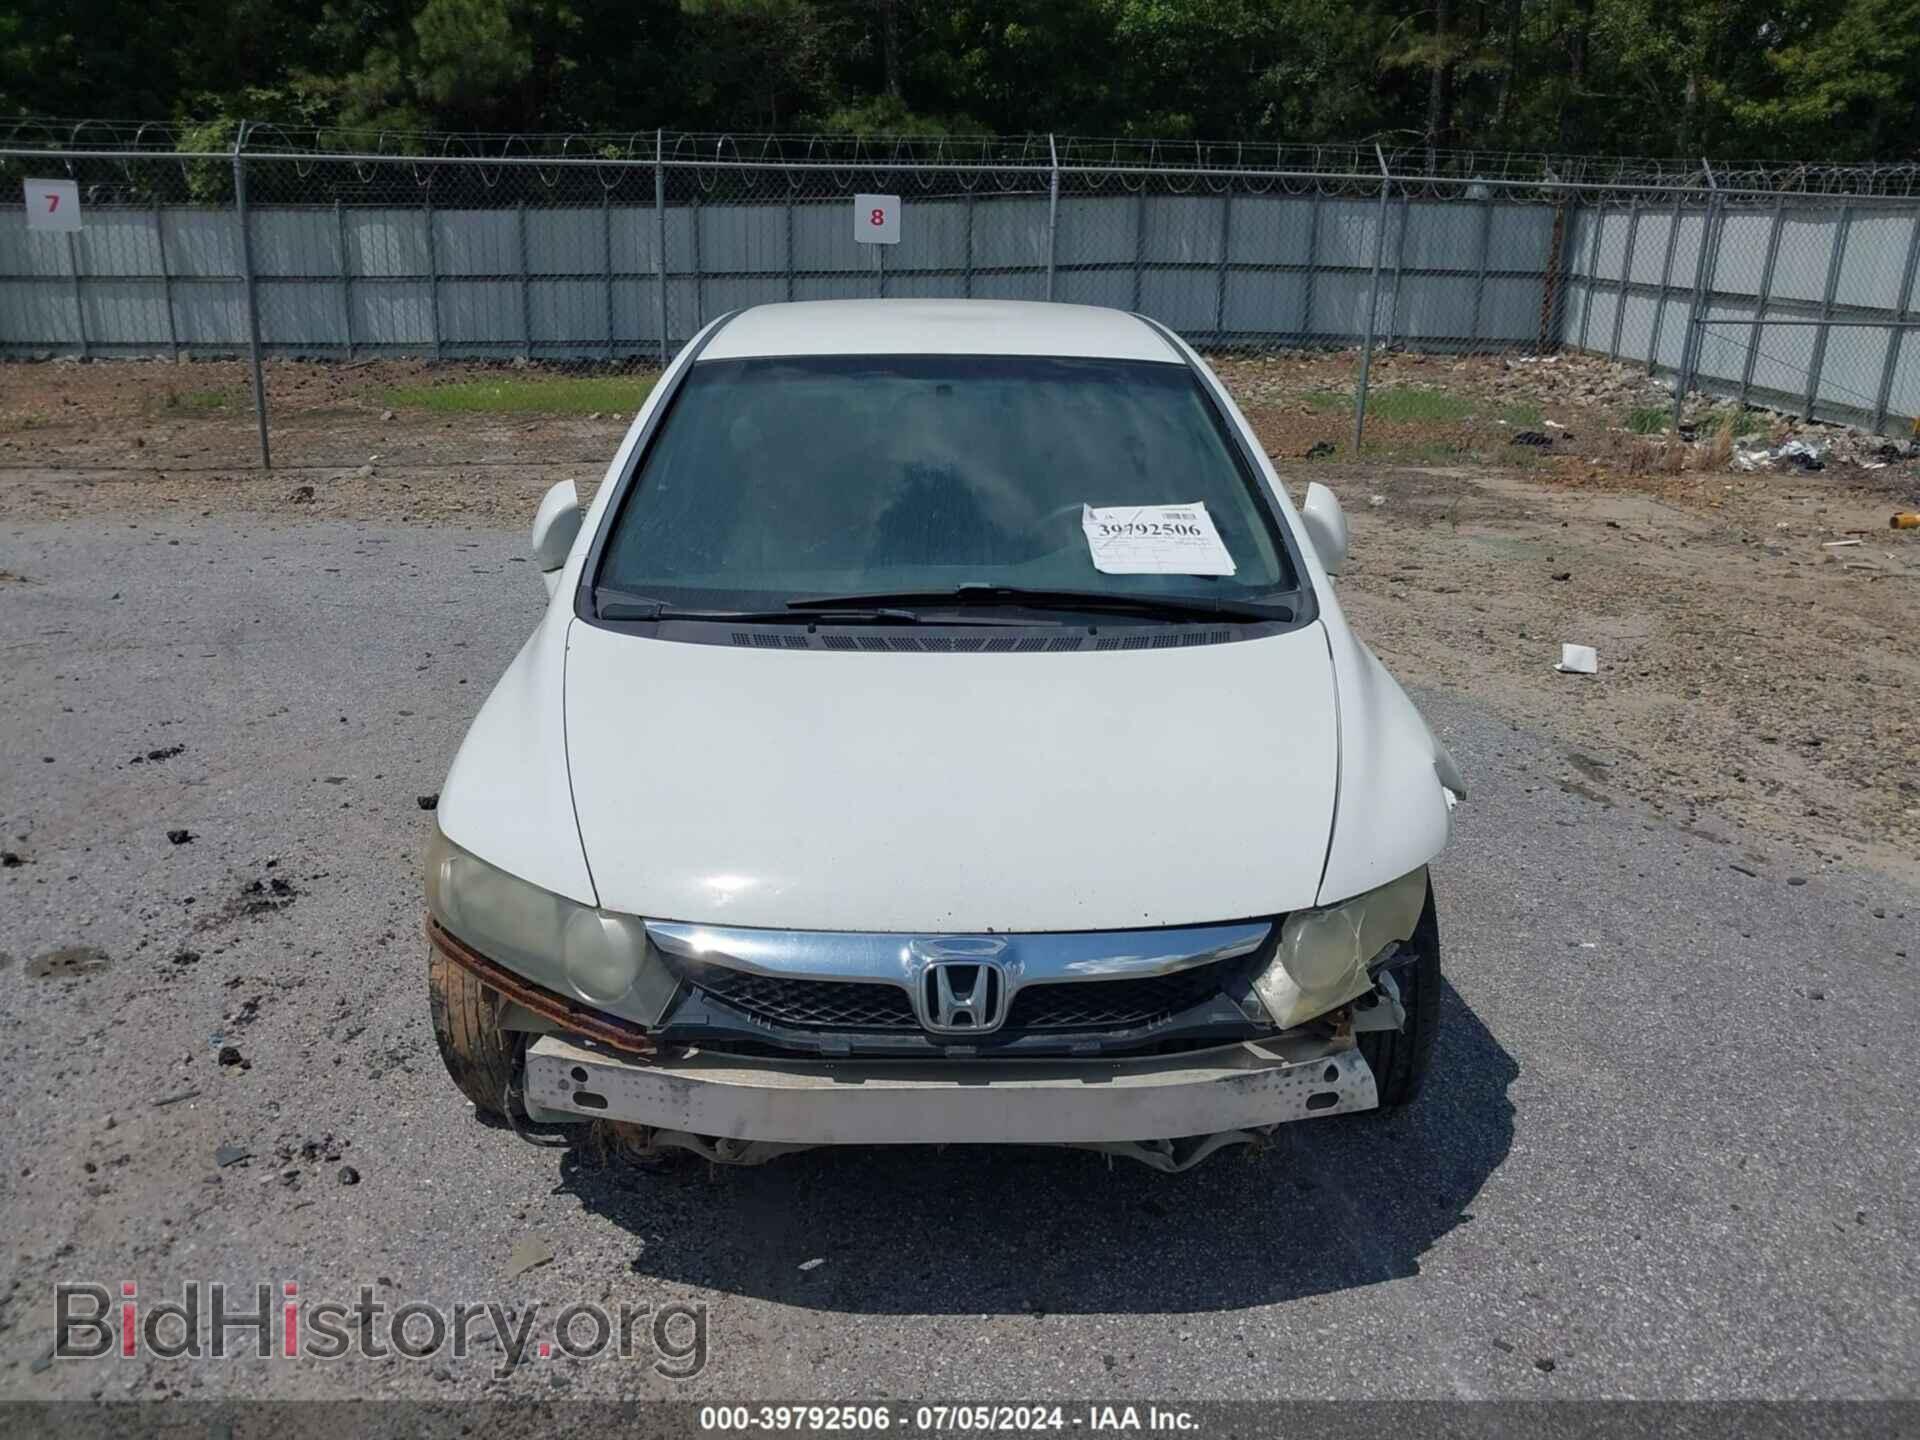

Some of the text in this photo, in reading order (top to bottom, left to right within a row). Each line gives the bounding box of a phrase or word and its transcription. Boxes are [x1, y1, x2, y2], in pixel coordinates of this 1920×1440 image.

[44, 193, 60, 213] 7
[871, 208, 885, 226] 8
[1099, 523, 1201, 536] 39792506
